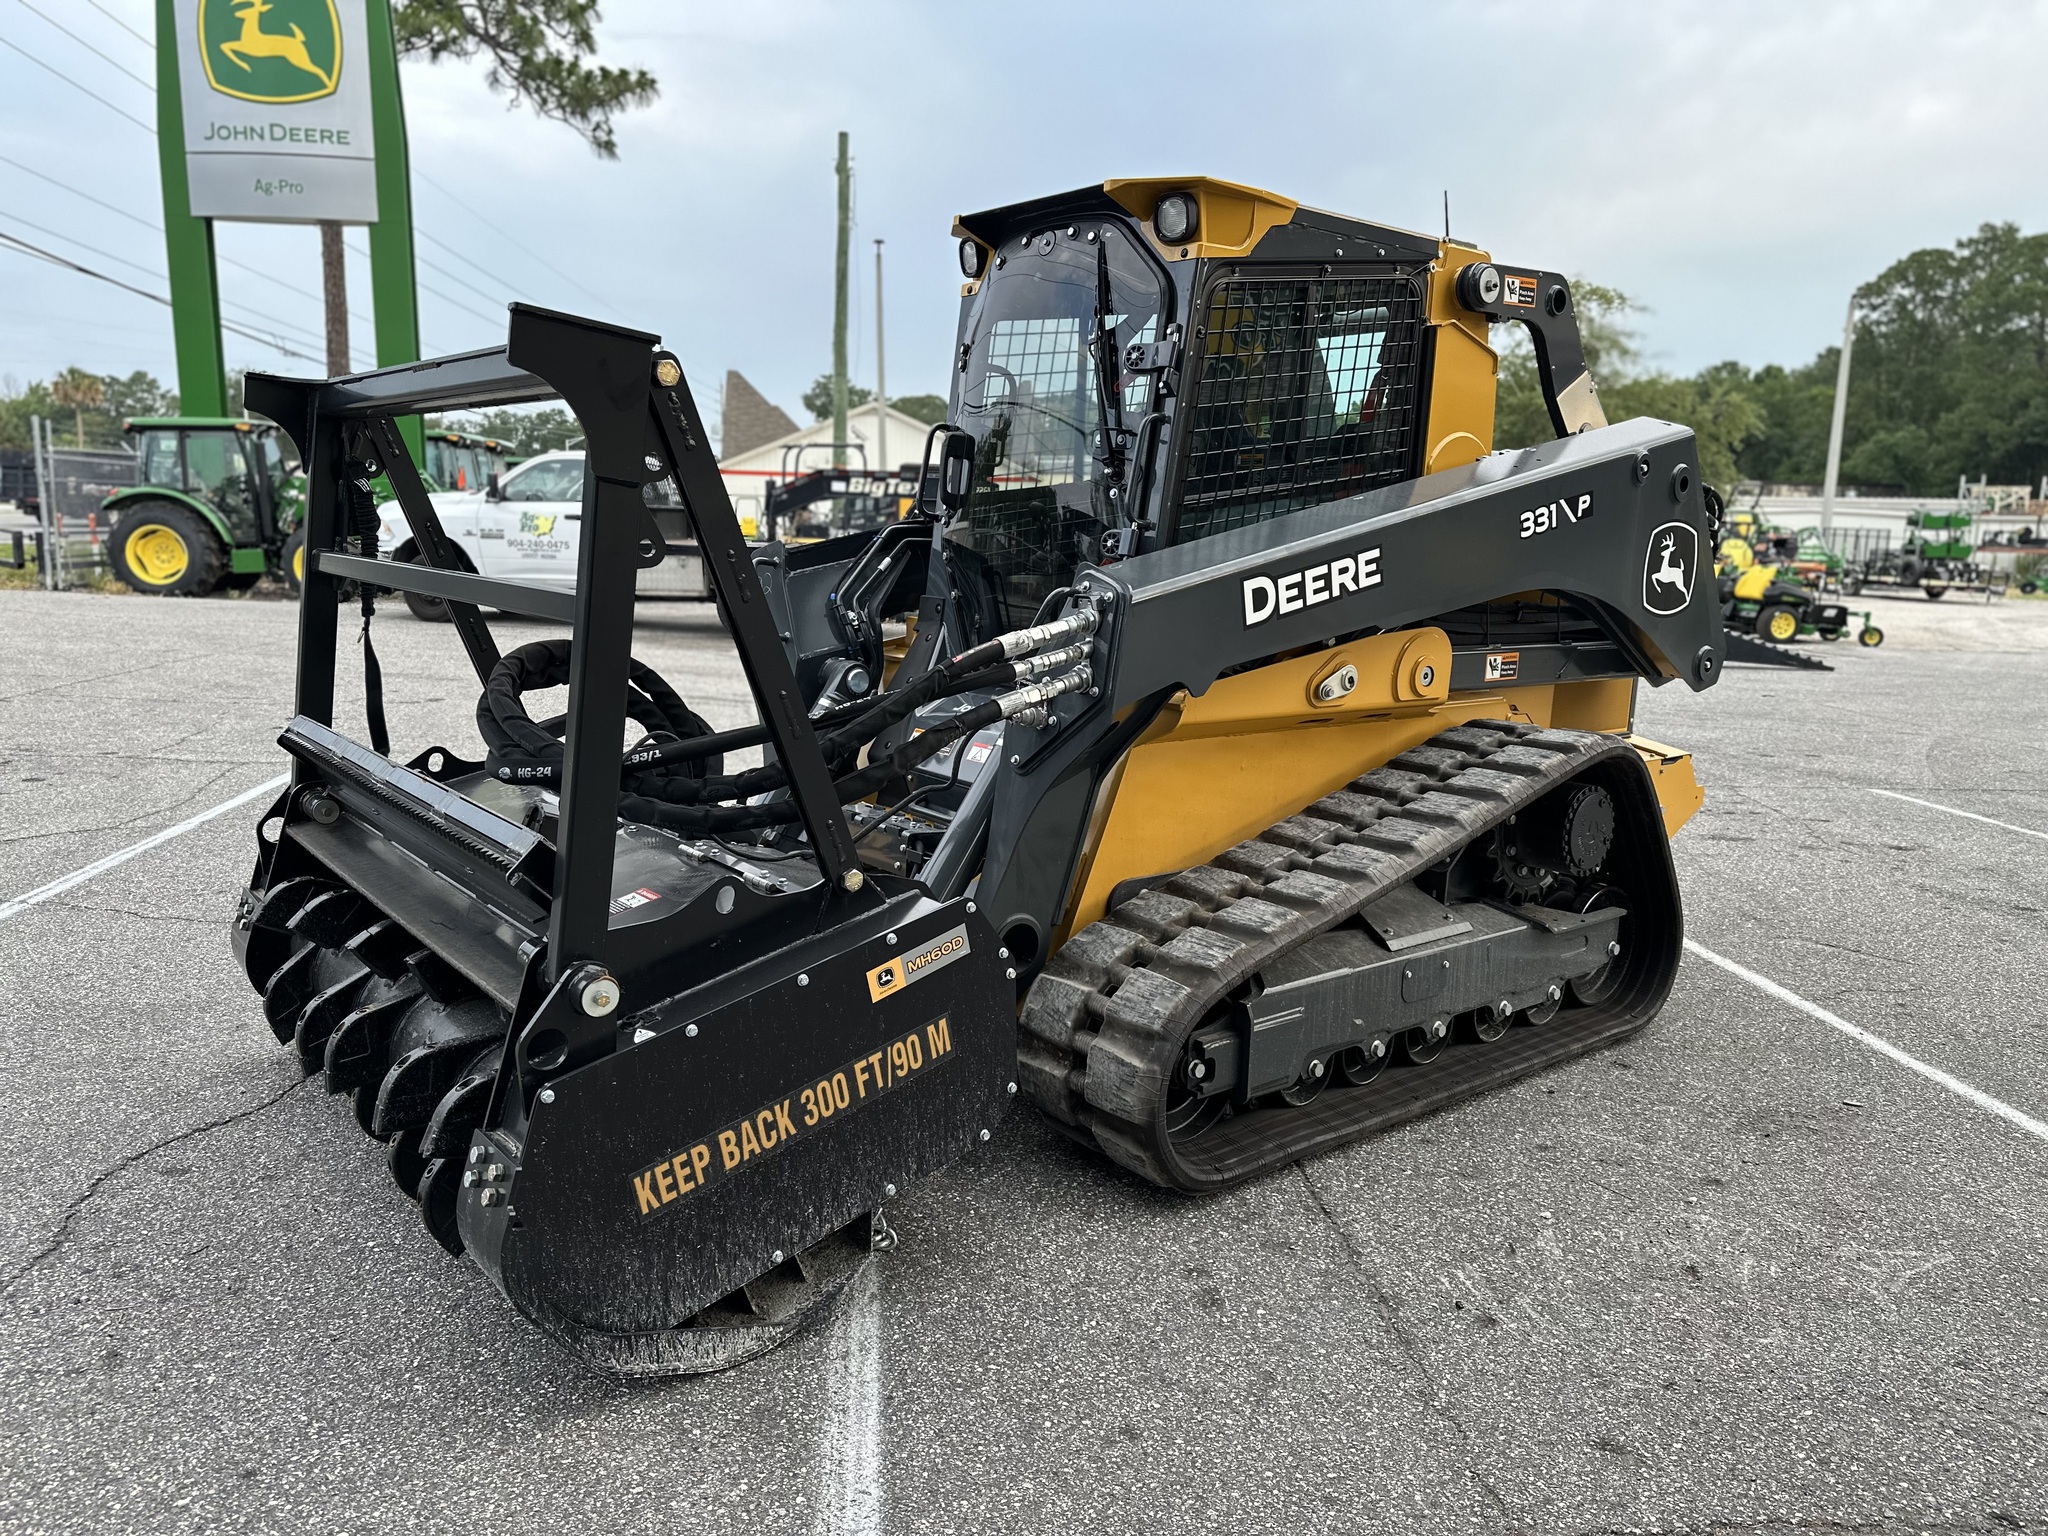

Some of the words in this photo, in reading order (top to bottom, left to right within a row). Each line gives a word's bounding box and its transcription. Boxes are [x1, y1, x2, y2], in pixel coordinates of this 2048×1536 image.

[204, 122, 264, 141] JOHN
[269, 123, 350, 145] DEERE
[254, 179, 303, 195] Ag-Pro
[507, 539, 570, 549] 904-240-0475
[1243, 548, 1382, 626] DEERE
[517, 766, 551, 779] HG-24
[906, 935, 964, 975] MH60D
[632, 1143, 711, 1216] KEEP
[717, 1098, 797, 1173] BACK
[800, 1071, 850, 1127] 300
[854, 1033, 922, 1098] FT/90
[926, 1017, 952, 1060] M
